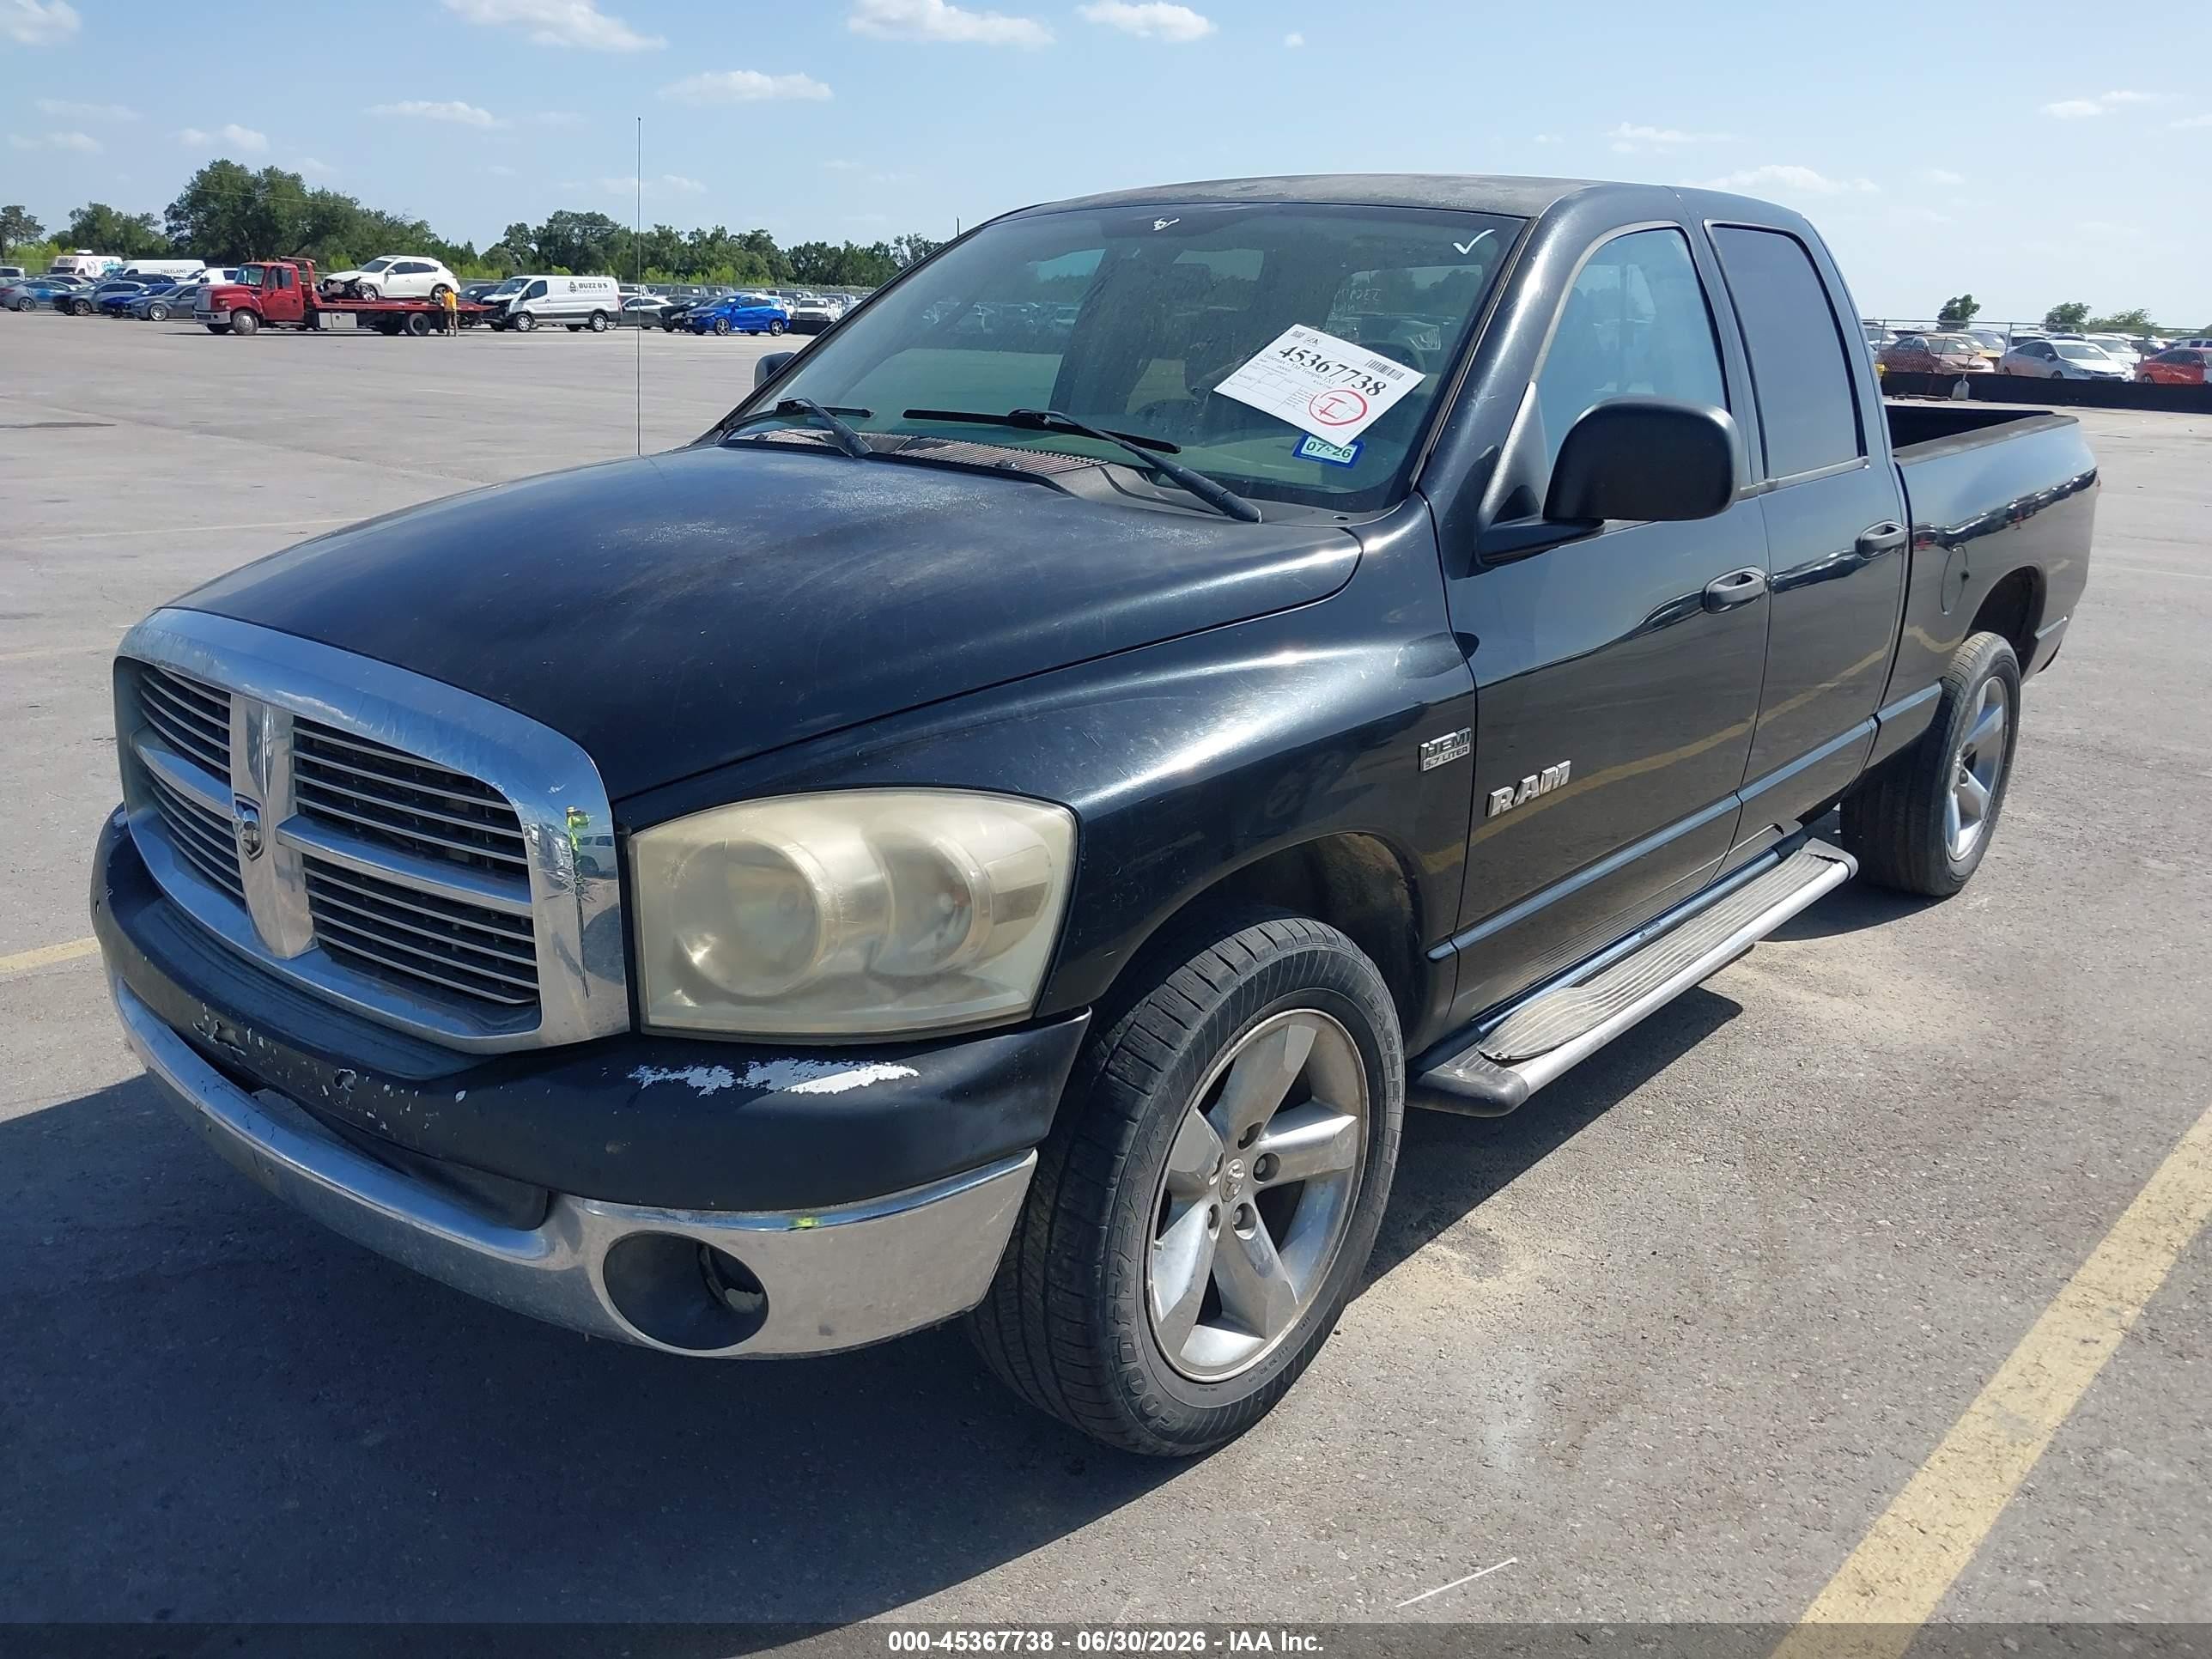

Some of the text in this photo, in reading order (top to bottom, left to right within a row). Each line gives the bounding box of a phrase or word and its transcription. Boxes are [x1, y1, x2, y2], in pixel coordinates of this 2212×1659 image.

[1279, 345, 1387, 396] 45367738
[1306, 441, 1353, 459] 07 26
[1419, 727, 1471, 759] HEMI
[1425, 745, 1469, 769] 5.7 LITER
[1486, 759, 1571, 817] RAM
